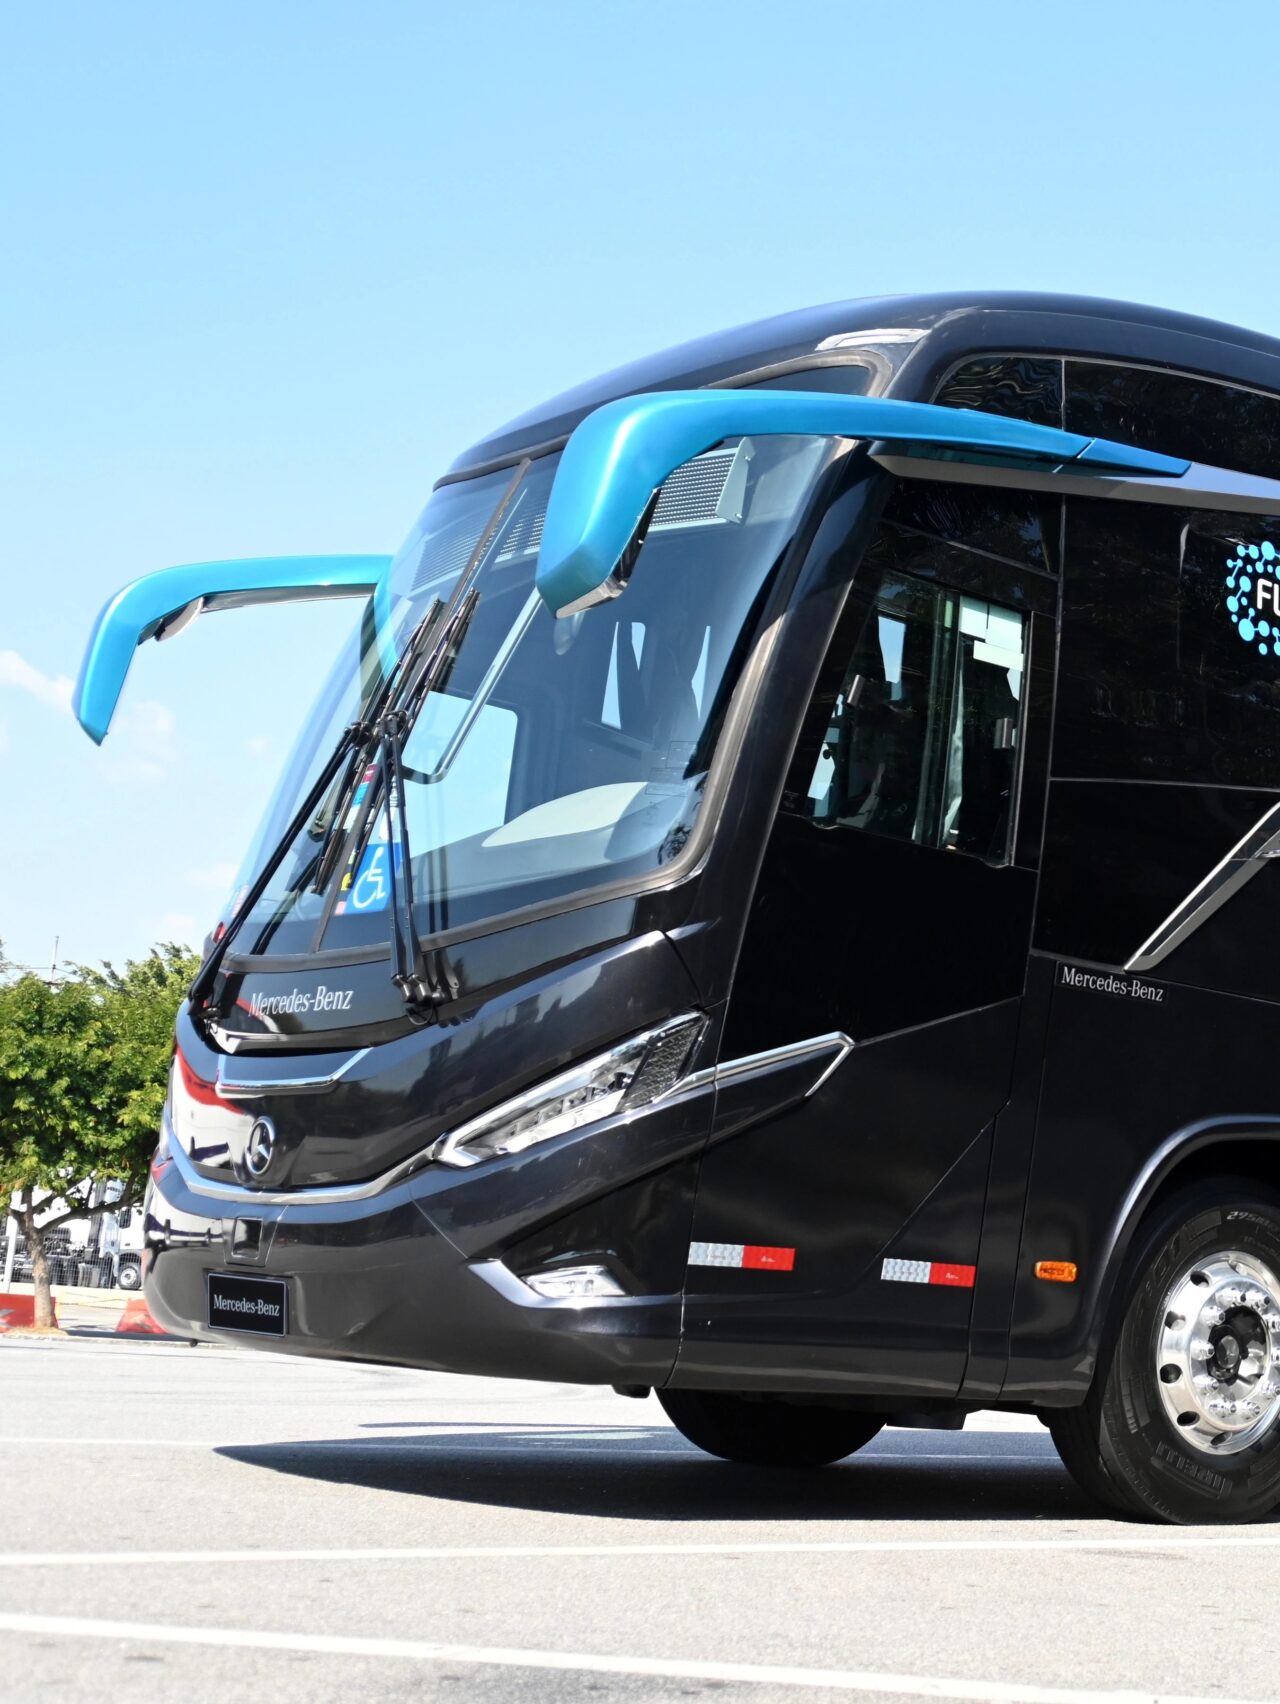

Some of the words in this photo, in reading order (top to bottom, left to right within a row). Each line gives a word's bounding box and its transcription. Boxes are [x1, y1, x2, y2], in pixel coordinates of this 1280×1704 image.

[1060, 965, 1165, 1002] Mercedes-Benz
[248, 985, 354, 1018] Mercedes-Benz
[212, 1293, 281, 1318] Mercedes-Benz
